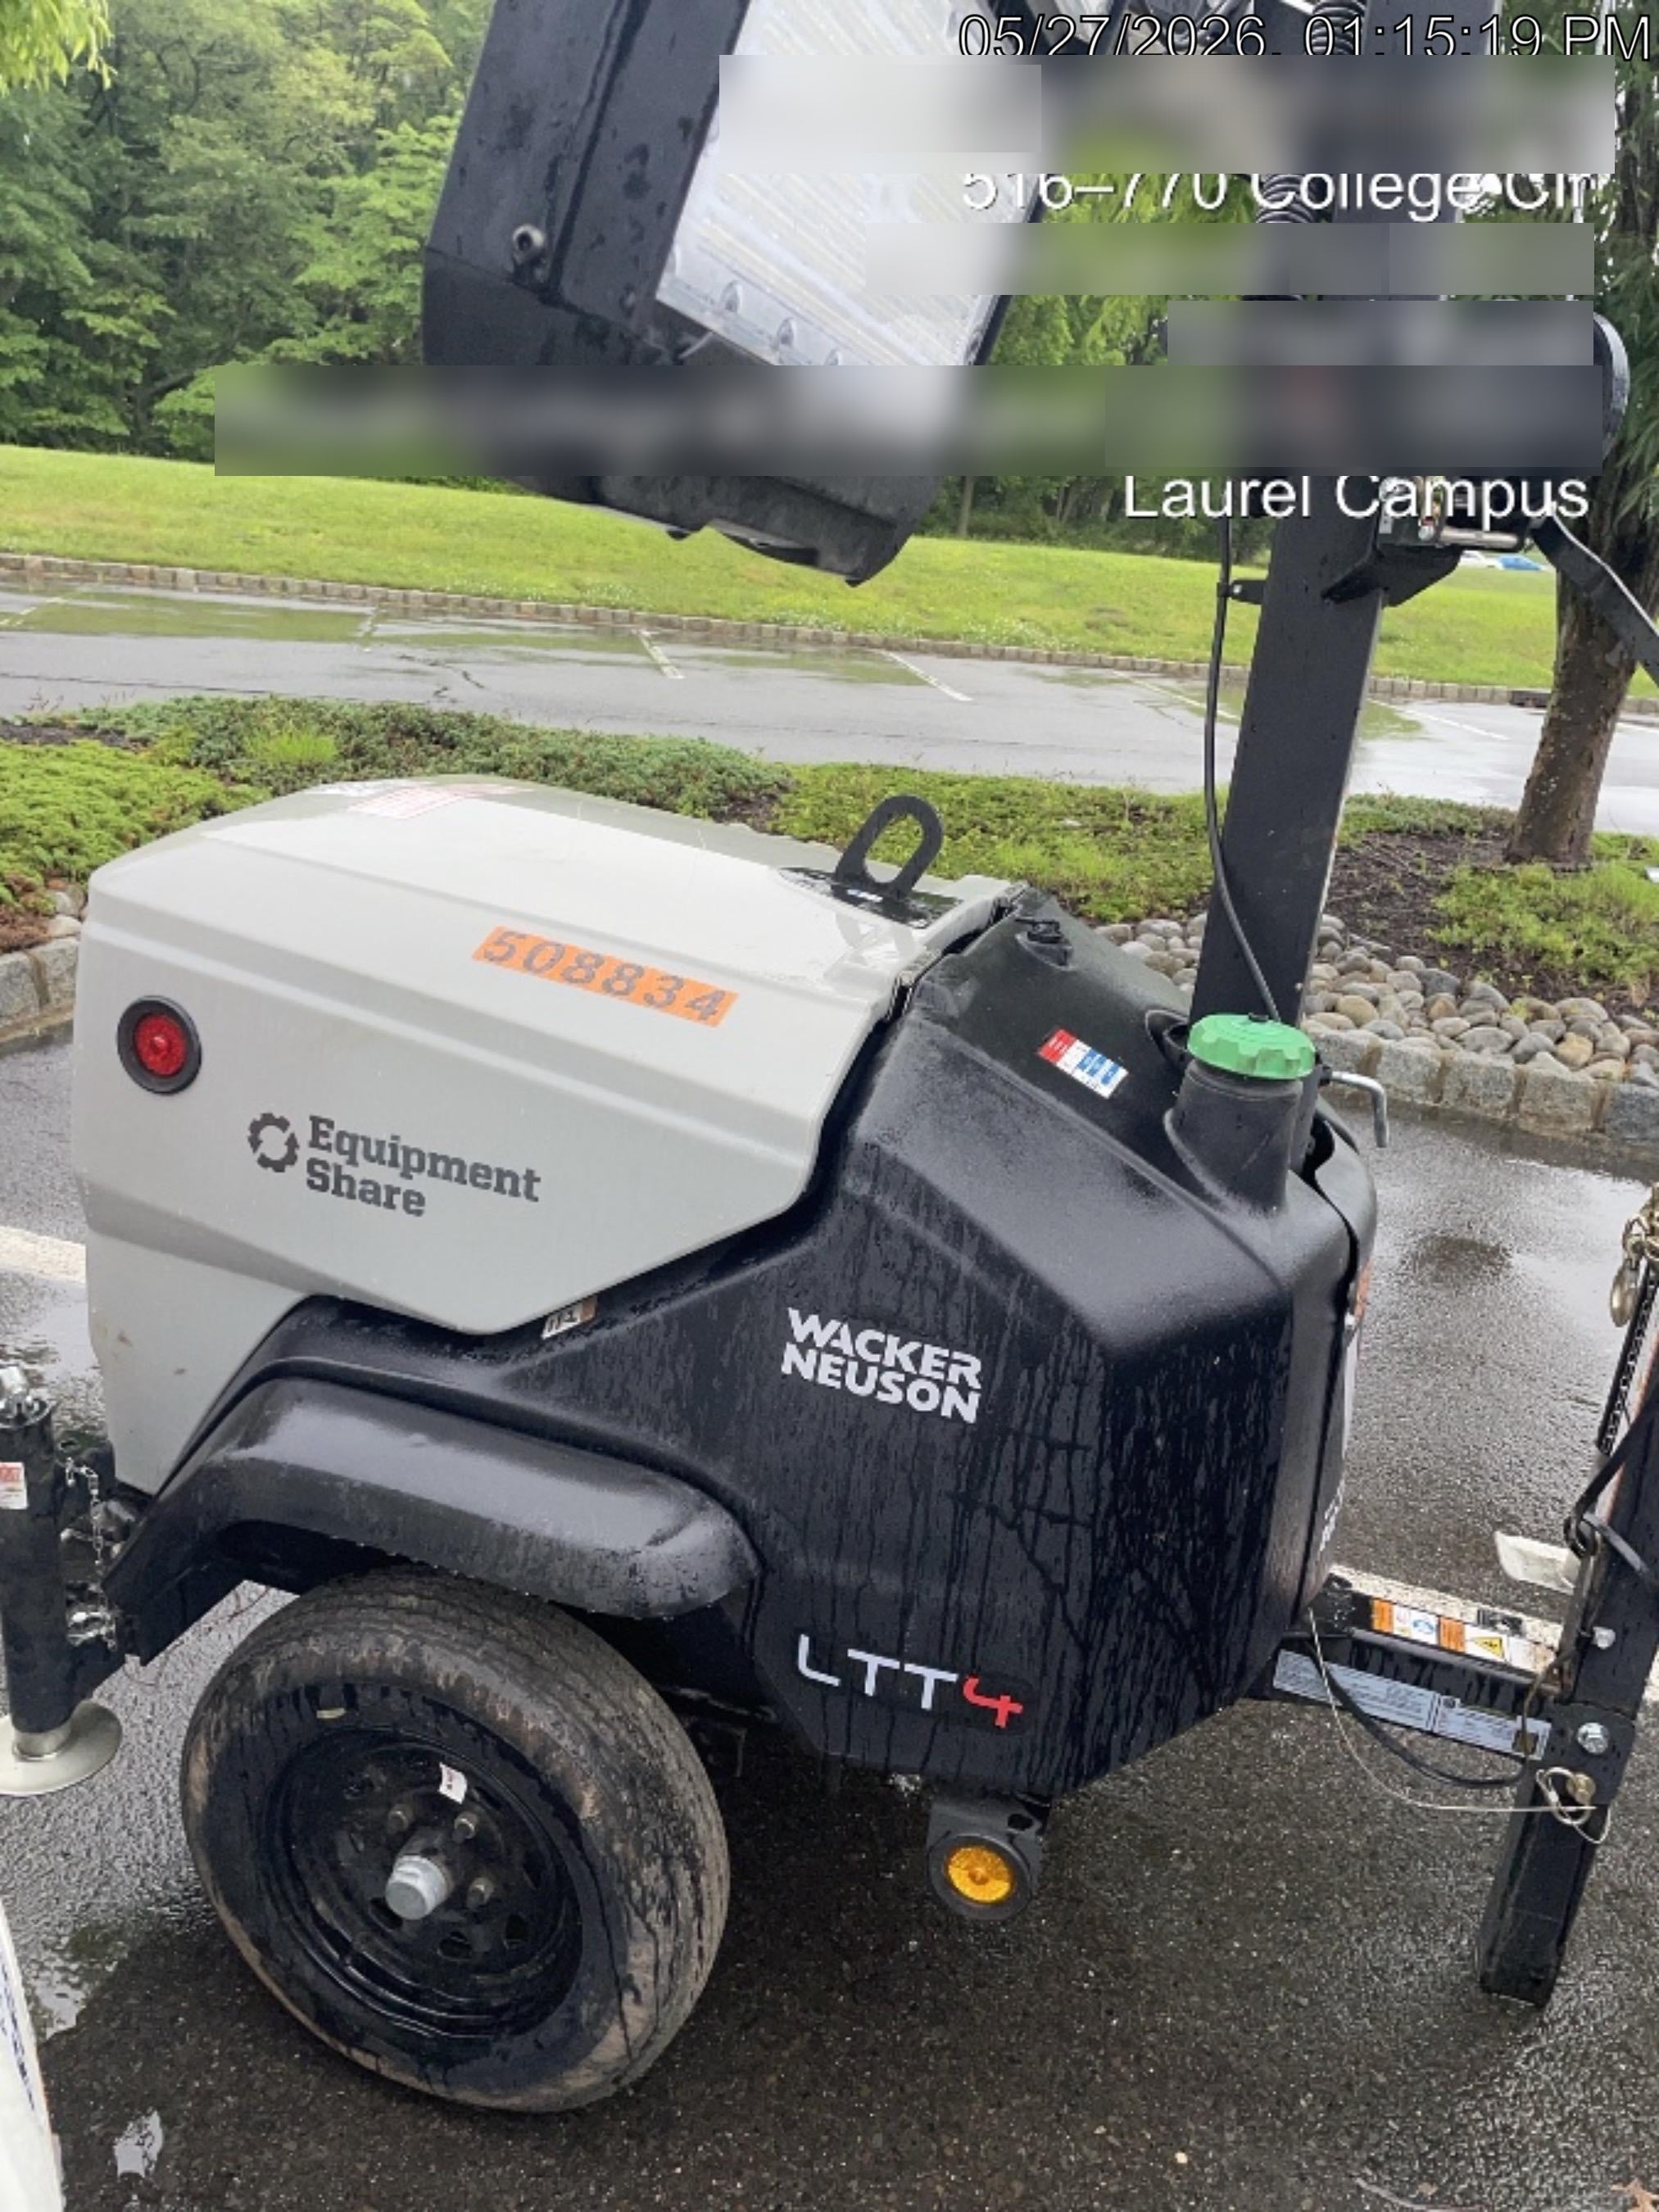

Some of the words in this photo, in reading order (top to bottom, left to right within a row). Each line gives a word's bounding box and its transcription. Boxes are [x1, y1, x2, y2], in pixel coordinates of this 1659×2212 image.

[482, 930, 728, 1022] 508834
[306, 1158, 426, 1217] Share
[308, 1115, 542, 1203] Equipment
[781, 1342, 981, 1424] NEUSON
[788, 1308, 981, 1389] WACKER
[797, 1634, 1023, 1729] LTT4
